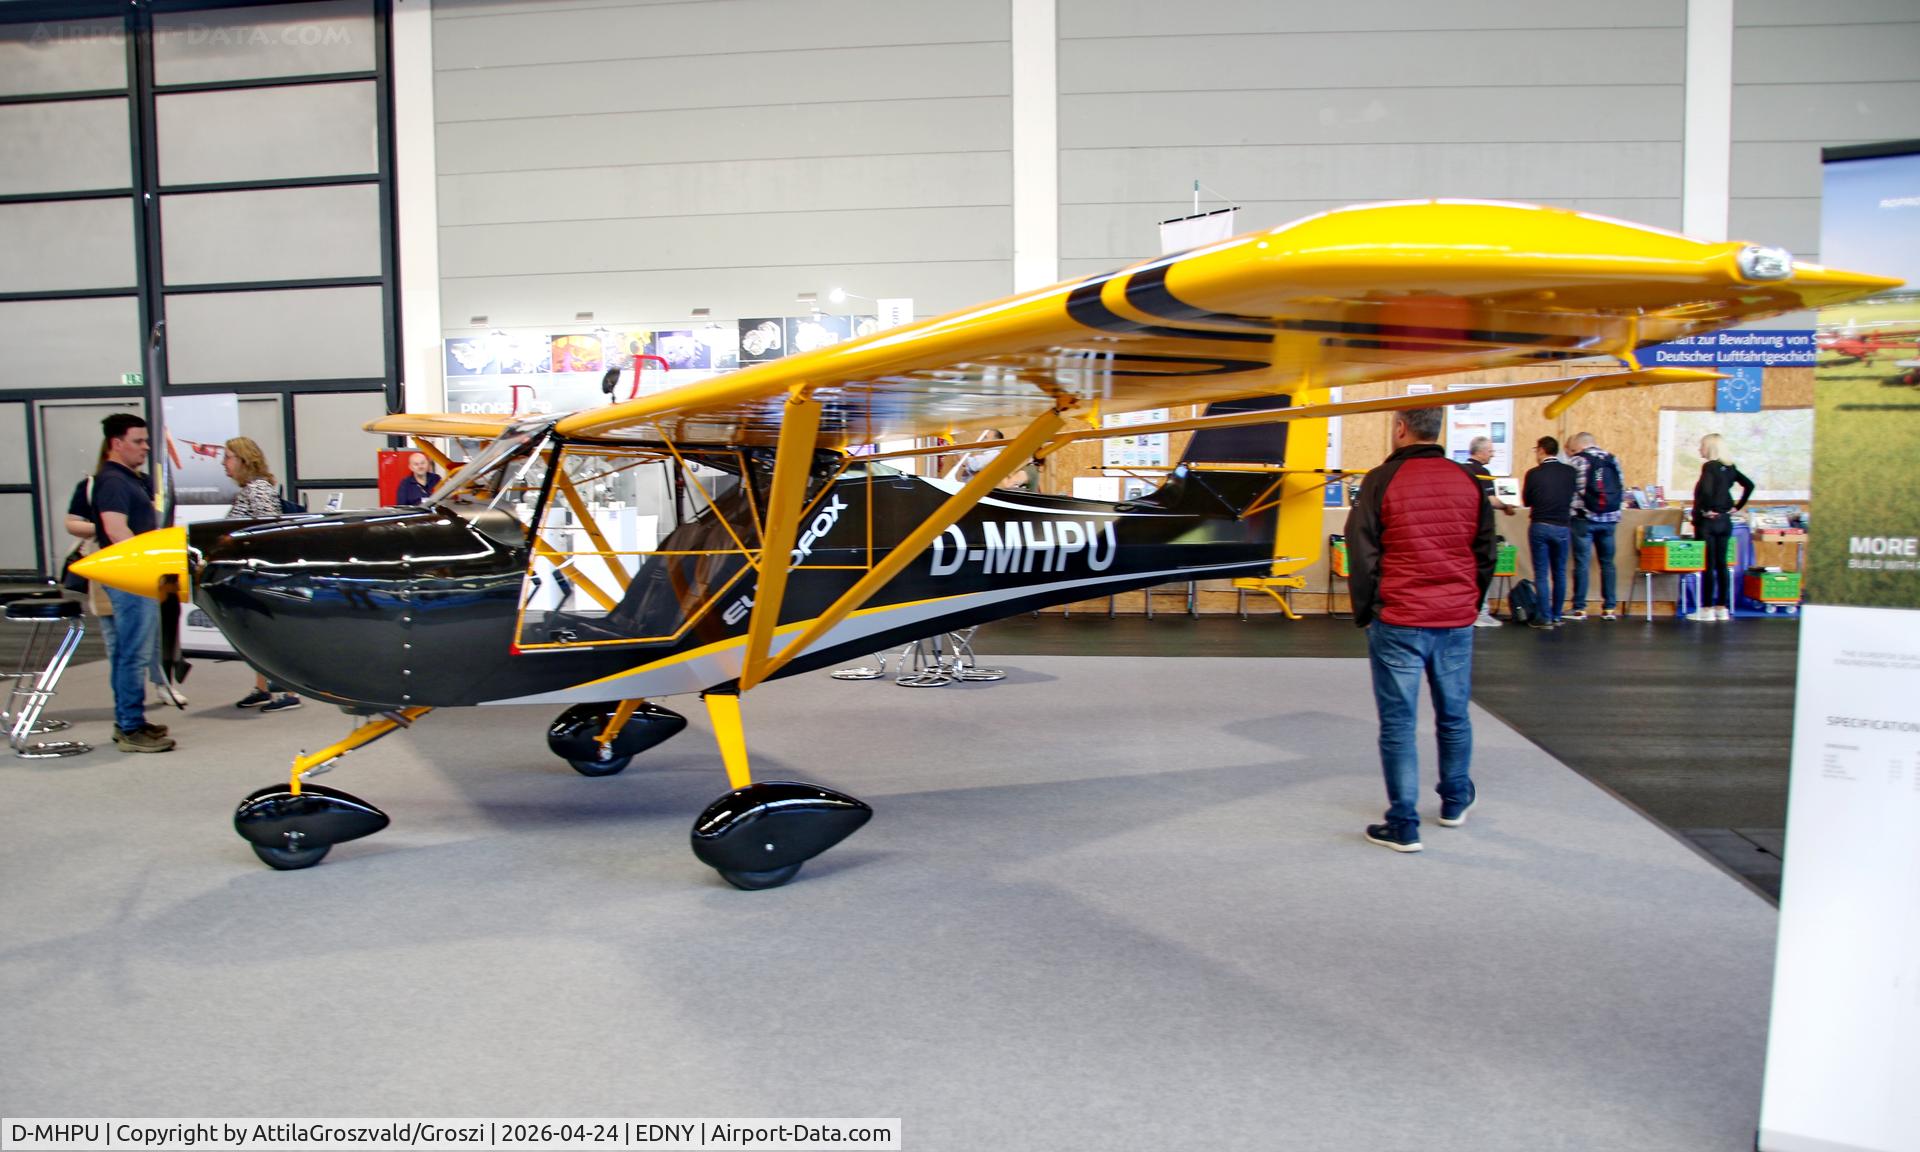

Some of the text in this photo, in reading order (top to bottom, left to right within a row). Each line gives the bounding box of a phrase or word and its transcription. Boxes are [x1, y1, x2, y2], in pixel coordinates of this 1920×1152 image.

[1699, 335, 1717, 345] zur
[1719, 333, 1783, 348] Bewahrung
[1787, 335, 1809, 345] von
[1656, 350, 1714, 362] Deutscher
[930, 521, 1117, 576] D-MHPU
[1849, 536, 1918, 555] MORE
